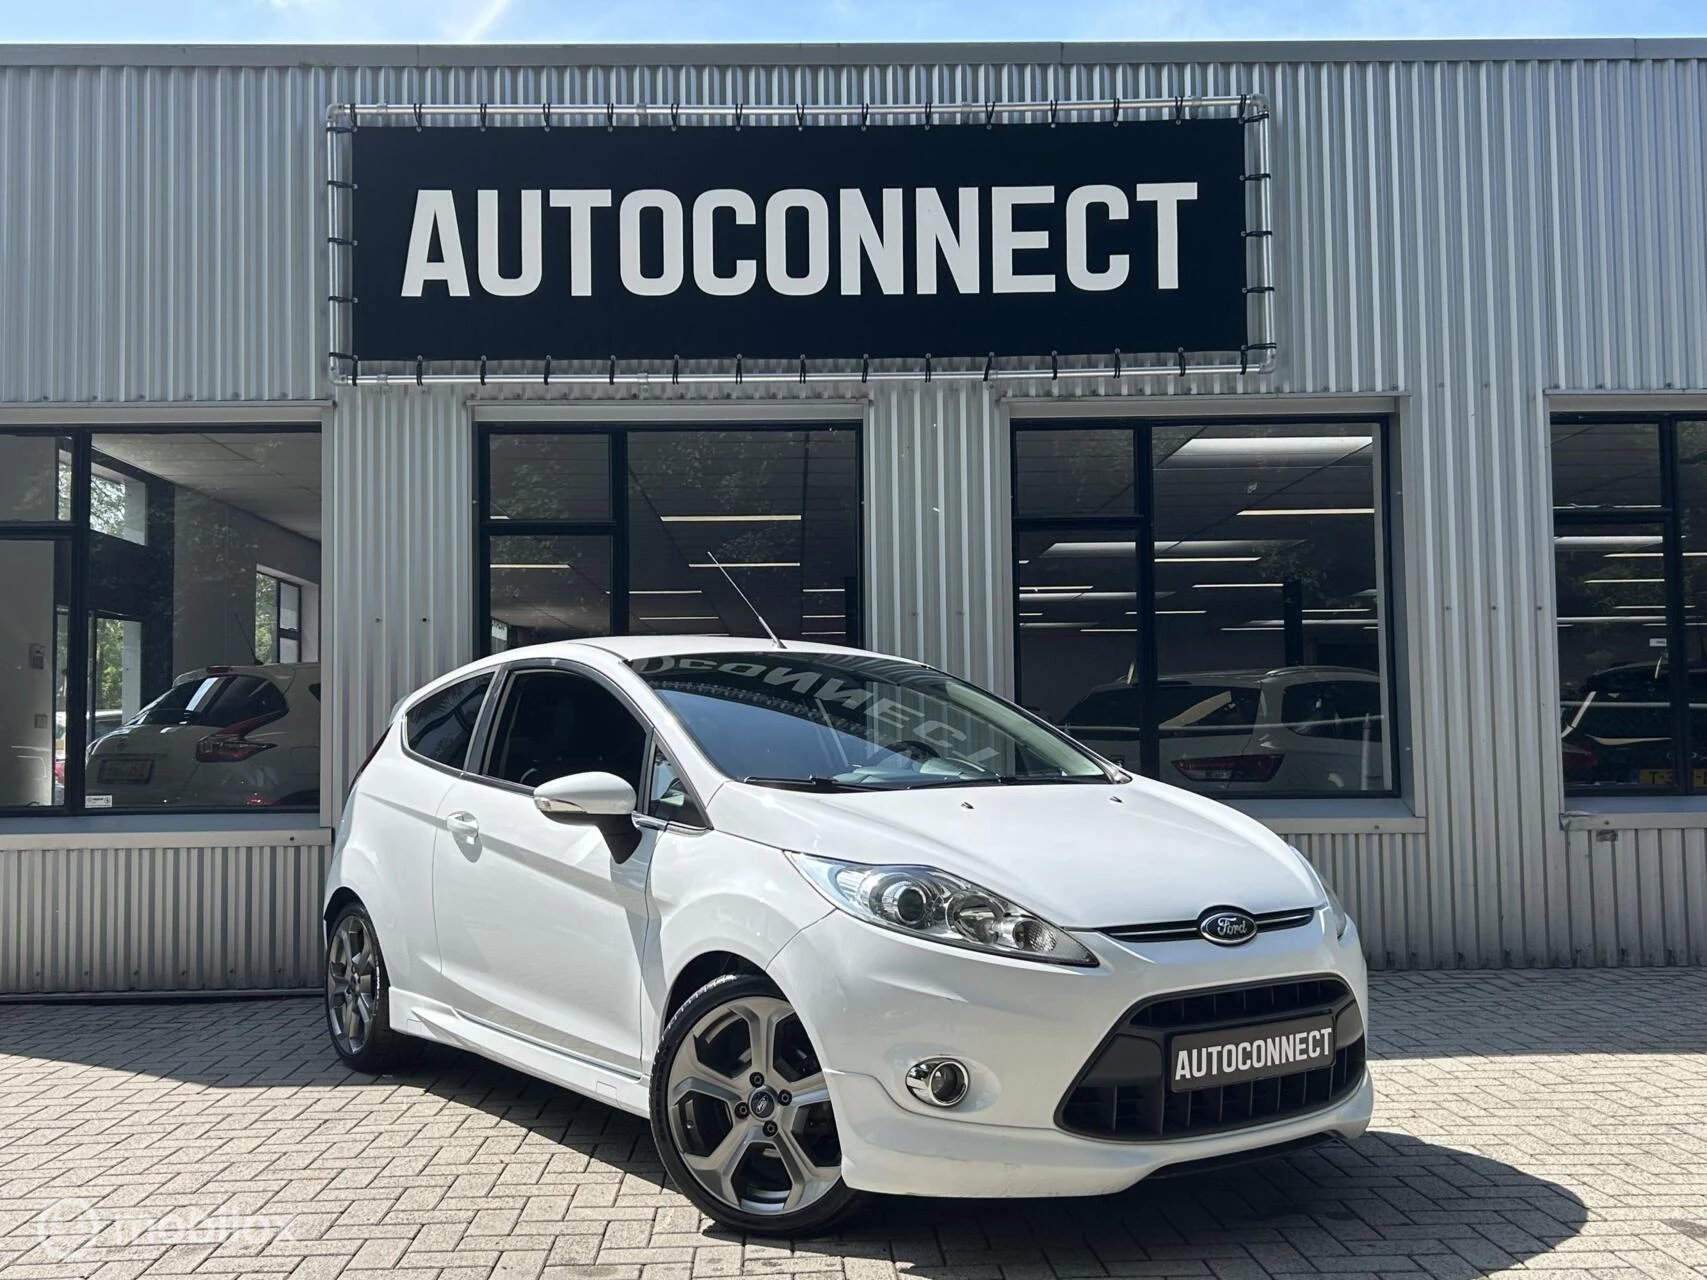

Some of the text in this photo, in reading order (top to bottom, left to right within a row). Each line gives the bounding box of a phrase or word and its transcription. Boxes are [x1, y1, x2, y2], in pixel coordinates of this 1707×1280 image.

[401, 182, 1198, 297] AUTOCONNECT
[1217, 918, 1247, 936] Ford
[1175, 1028, 1333, 1080] AUTOCONNECT
